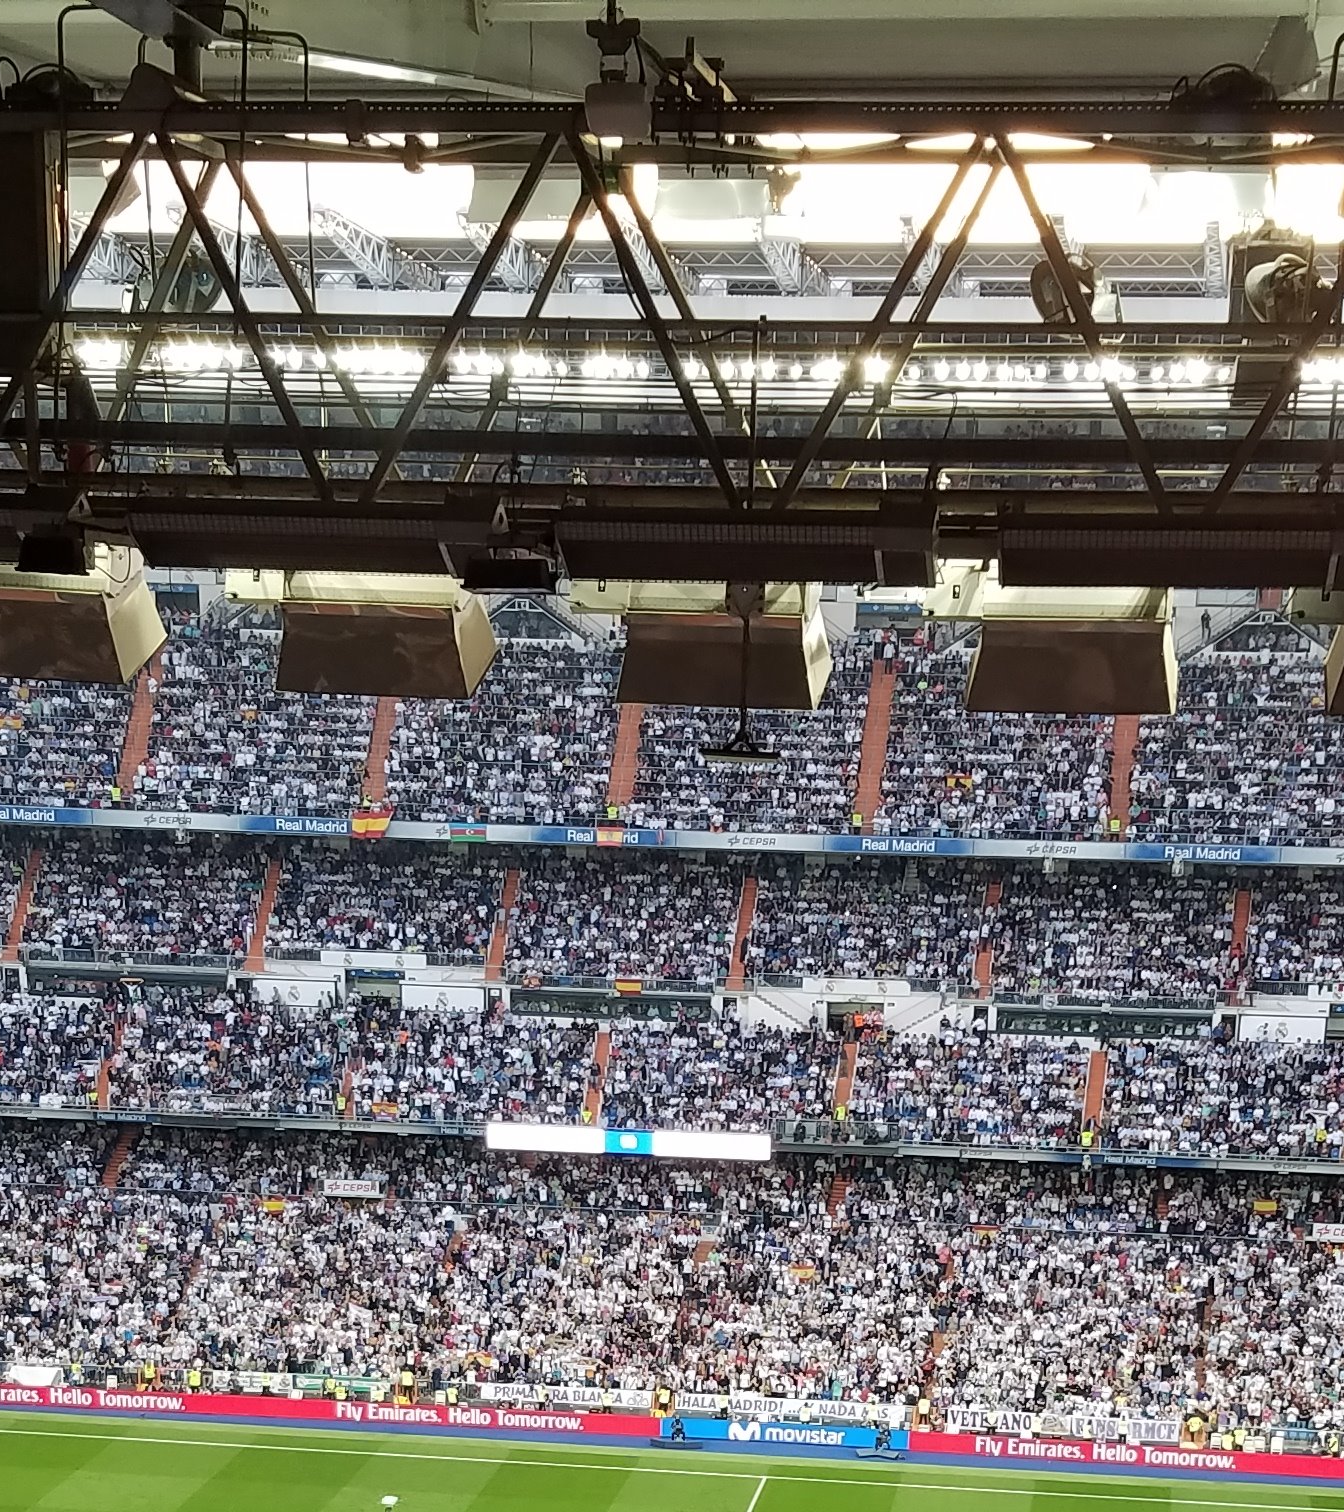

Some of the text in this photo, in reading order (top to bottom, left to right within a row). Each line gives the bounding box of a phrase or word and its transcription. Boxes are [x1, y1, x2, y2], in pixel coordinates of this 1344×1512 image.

[12, 809, 55, 822] Madrid
[159, 815, 191, 825] CEPSA
[276, 819, 347, 833] Real Madrid
[567, 830, 593, 842] Real
[743, 837, 776, 846] CEPSA
[862, 839, 935, 852] Real Madrid
[1042, 845, 1076, 855] CEPSA
[1164, 846, 1241, 860] Real Madrid
[118, 1113, 146, 1121] Madrid
[1126, 1156, 1156, 1165] Madrid
[343, 1183, 376, 1192] CEPSA
[50, 1388, 93, 1405] Hello
[97, 1390, 185, 1410] Tomorrow.
[336, 1403, 584, 1430] Fly Emirates. Hello Tomorrow.
[819, 1404, 860, 1418] NADA
[949, 1409, 1031, 1431] VETEANO
[765, 1427, 845, 1445] movistar
[976, 1437, 1236, 1469] Fly Emirates. Hello Tomorrow.
